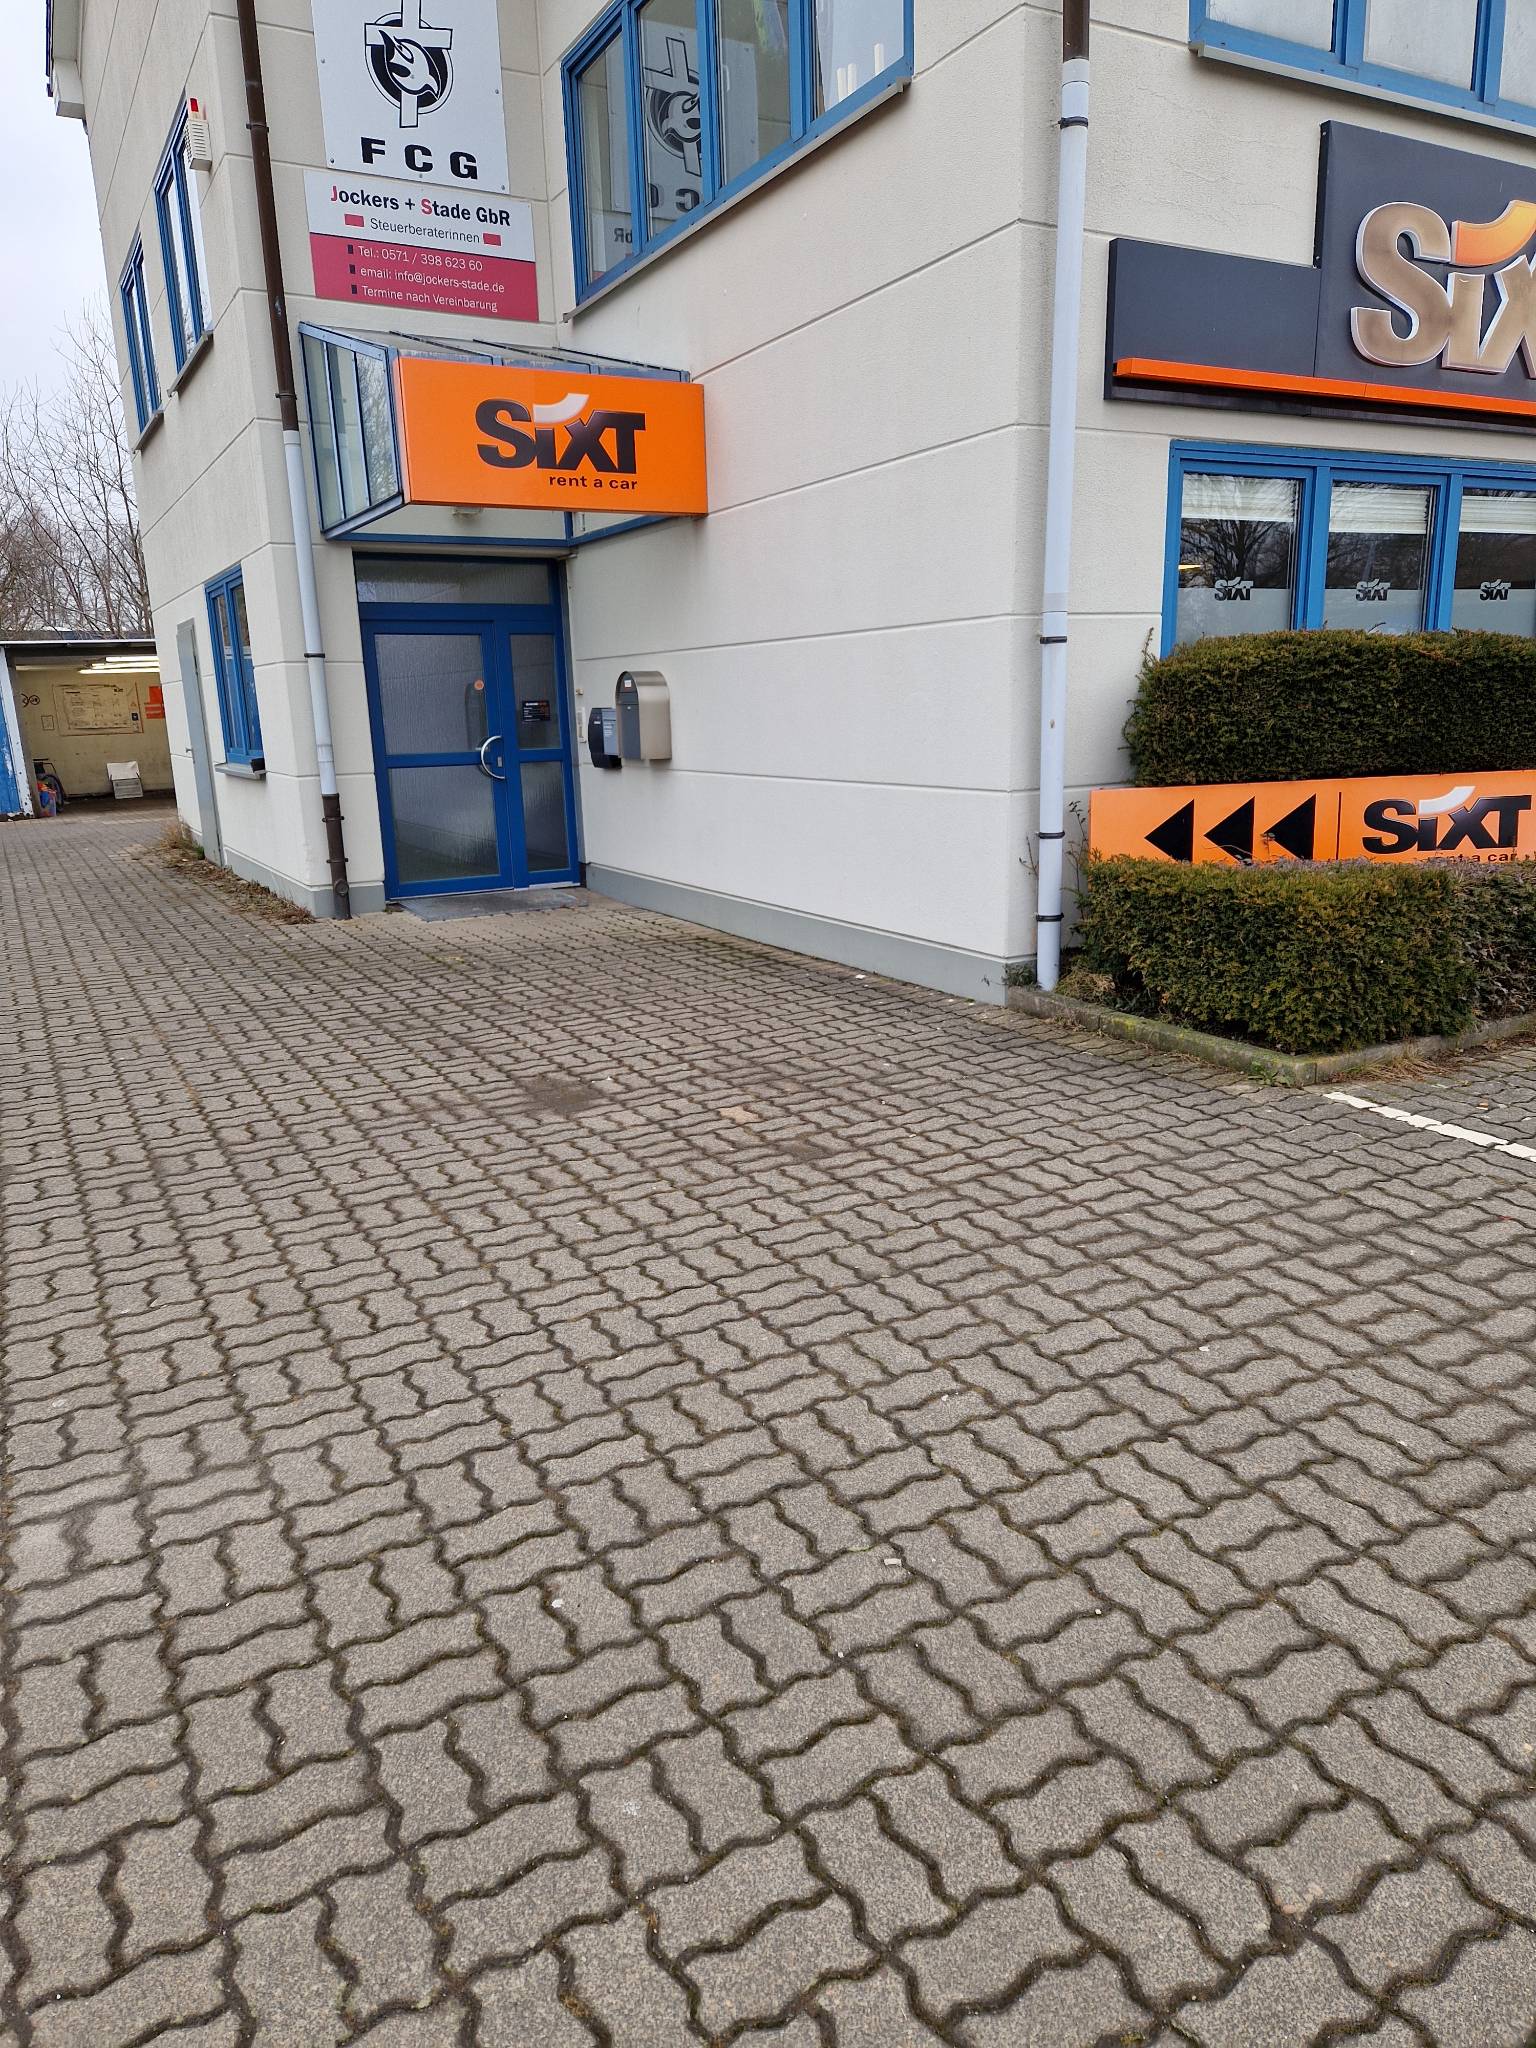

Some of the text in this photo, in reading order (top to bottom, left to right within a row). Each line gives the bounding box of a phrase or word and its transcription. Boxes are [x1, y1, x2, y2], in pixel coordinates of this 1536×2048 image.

[331, 186, 400, 210] Jockers
[421, 198, 471, 220] Stade
[476, 207, 510, 226] GbR
[370, 218, 480, 243] Steuerberaterinnen
[358, 245, 379, 258] Tel.:
[381, 248, 409, 262] 0571
[420, 253, 443, 266] 398
[444, 256, 466, 269] 623
[469, 259, 483, 272] 60
[360, 266, 505, 293] email: info@jockers-stade.de
[362, 285, 498, 312] Termine nach Vereinbarung
[549, 475, 638, 490] rent a car
